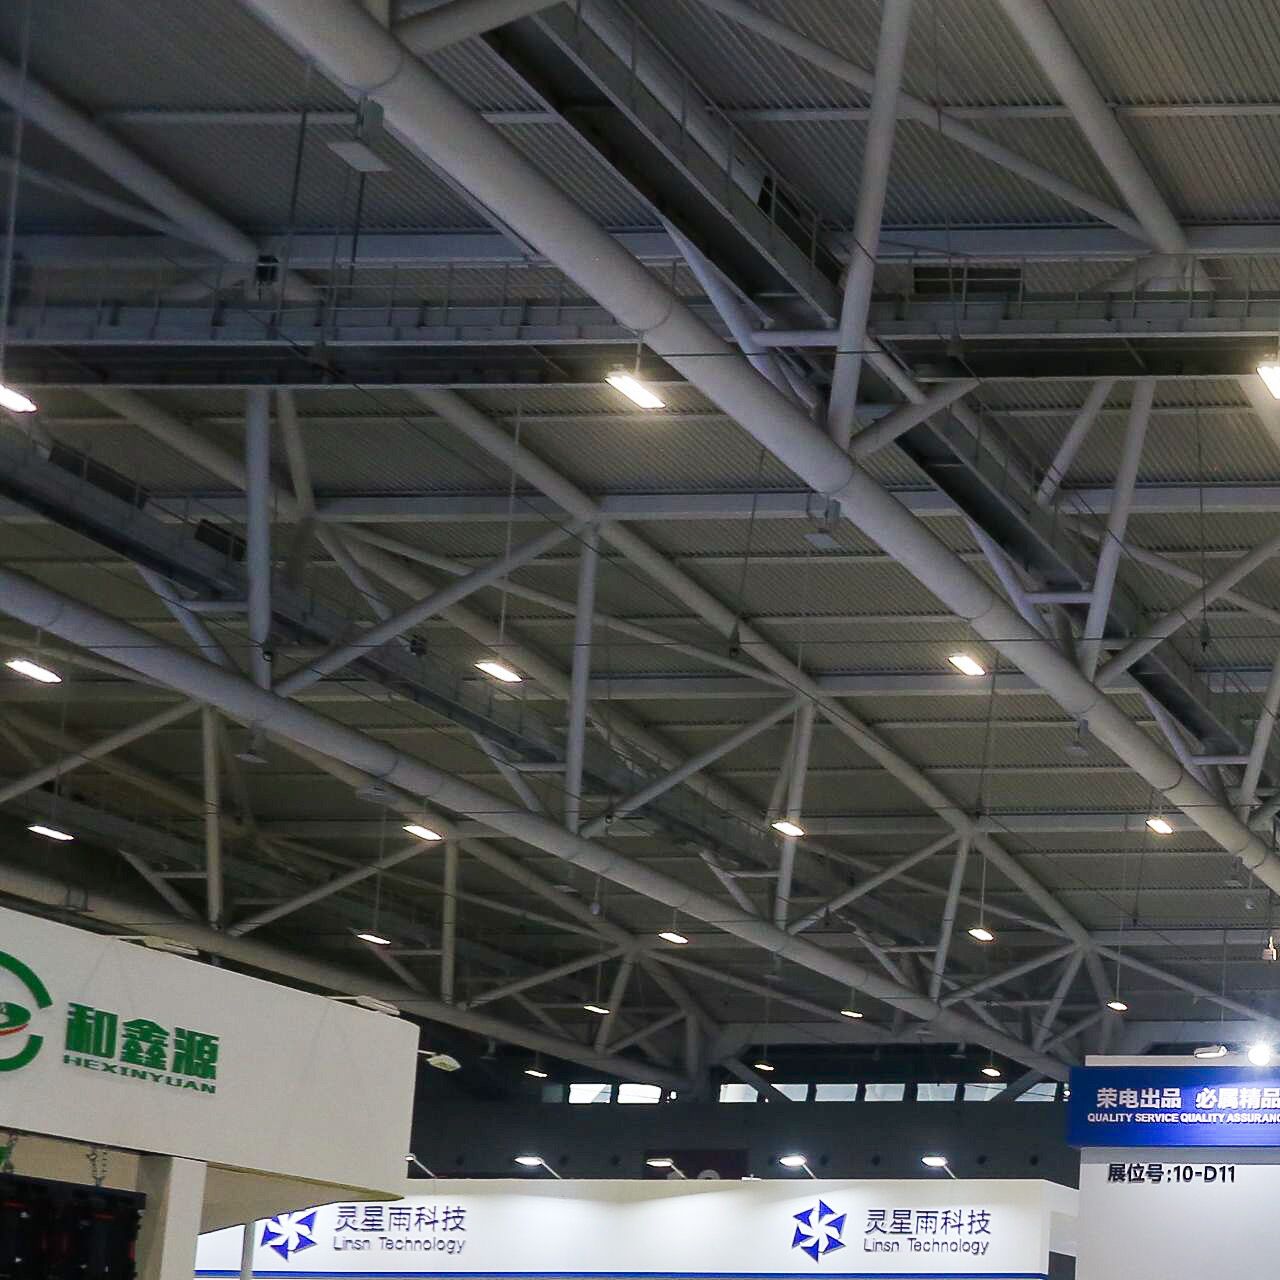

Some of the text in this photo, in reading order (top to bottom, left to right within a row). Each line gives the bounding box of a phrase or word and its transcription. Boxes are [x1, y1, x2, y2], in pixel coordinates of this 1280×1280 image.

[66, 1002, 219, 1079] 和鑫源
[63, 1055, 216, 1094] HEXINYUAN
[1097, 1087, 1181, 1109] 荣电出品
[1088, 1113, 1132, 1123] QUALITY
[1135, 1113, 1179, 1123] SERVICE
[1180, 1113, 1226, 1124] QUALITY
[334, 1206, 466, 1232] 灵星雨科技
[865, 1210, 991, 1235] 灵星雨科技
[333, 1237, 465, 1255] Linsn Technology
[864, 1238, 989, 1255] Linsn Technology
